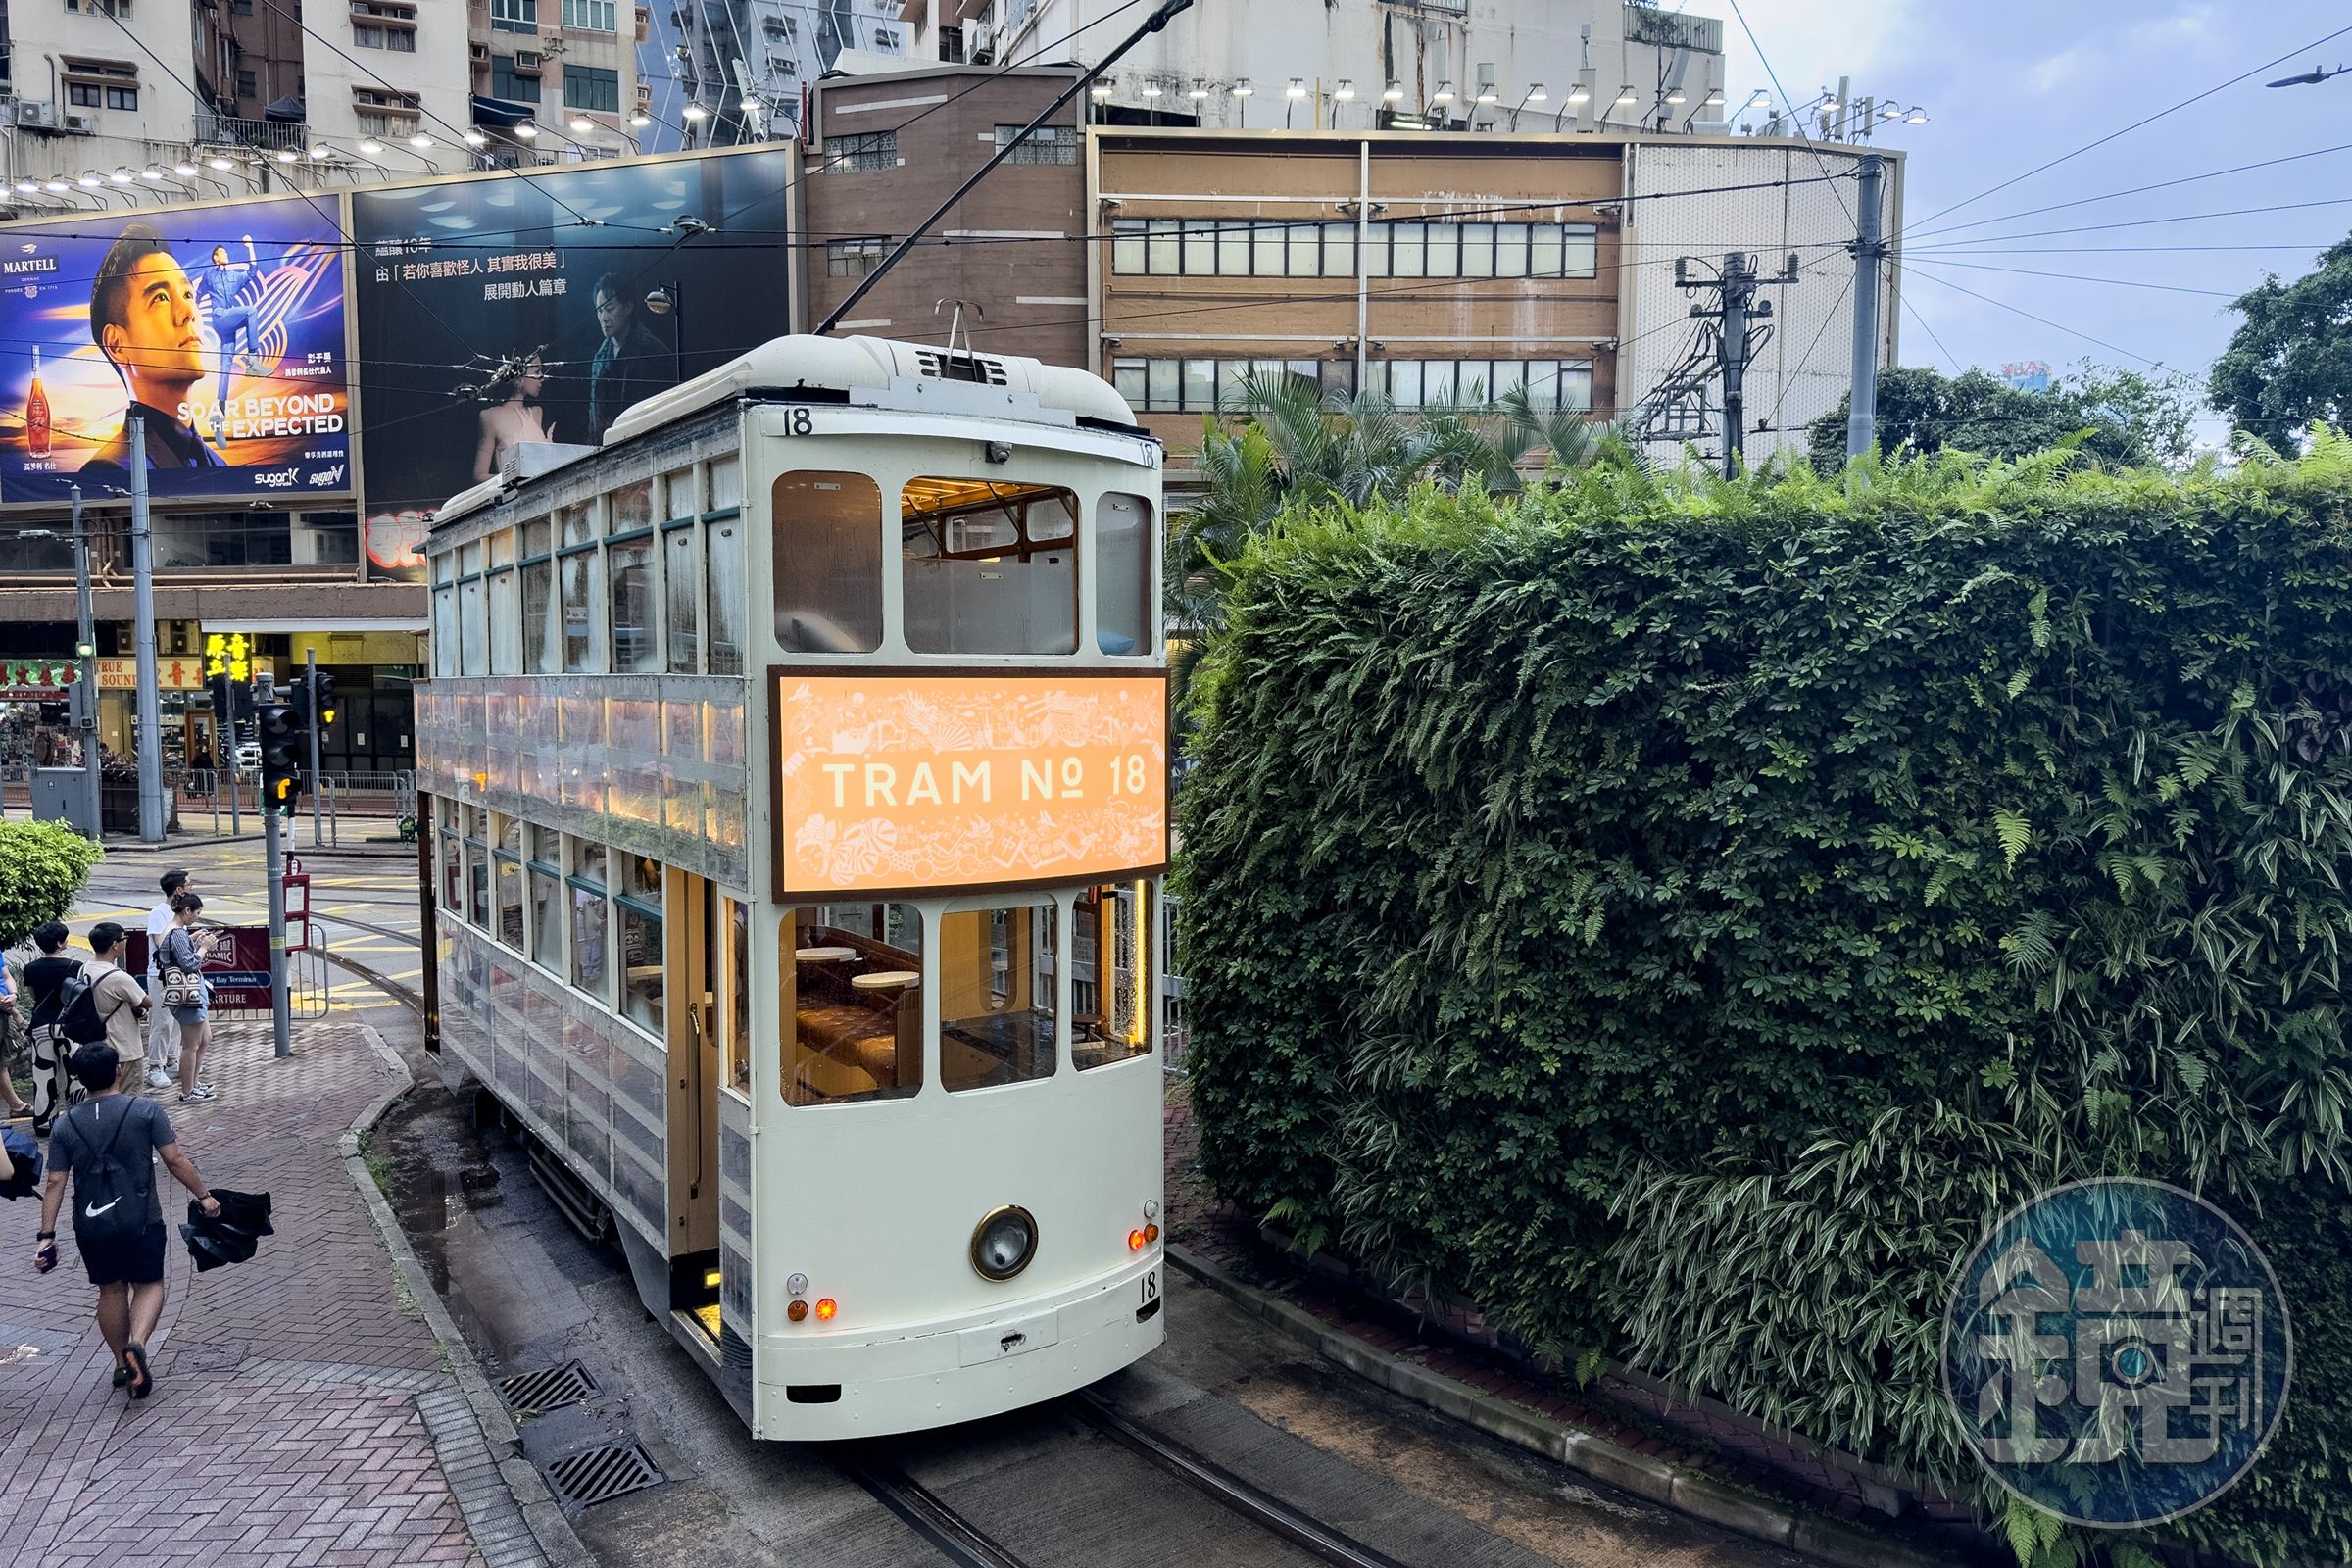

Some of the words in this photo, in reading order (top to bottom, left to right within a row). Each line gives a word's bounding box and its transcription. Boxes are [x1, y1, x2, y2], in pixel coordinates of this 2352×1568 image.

[4, 259, 56, 273] MARTELL
[484, 278, 567, 301] 展開動人篇章
[177, 400, 239, 421] SOAR
[245, 393, 335, 417] BEYOND
[208, 419, 229, 432] THE
[233, 415, 343, 438] EXPECTED
[784, 407, 813, 437] 18
[1140, 442, 1154, 468] 18
[98, 661, 123, 673] RUE
[822, 760, 992, 808] TRAM
[1109, 754, 1146, 795] 18
[1140, 1271, 1156, 1304] 18
